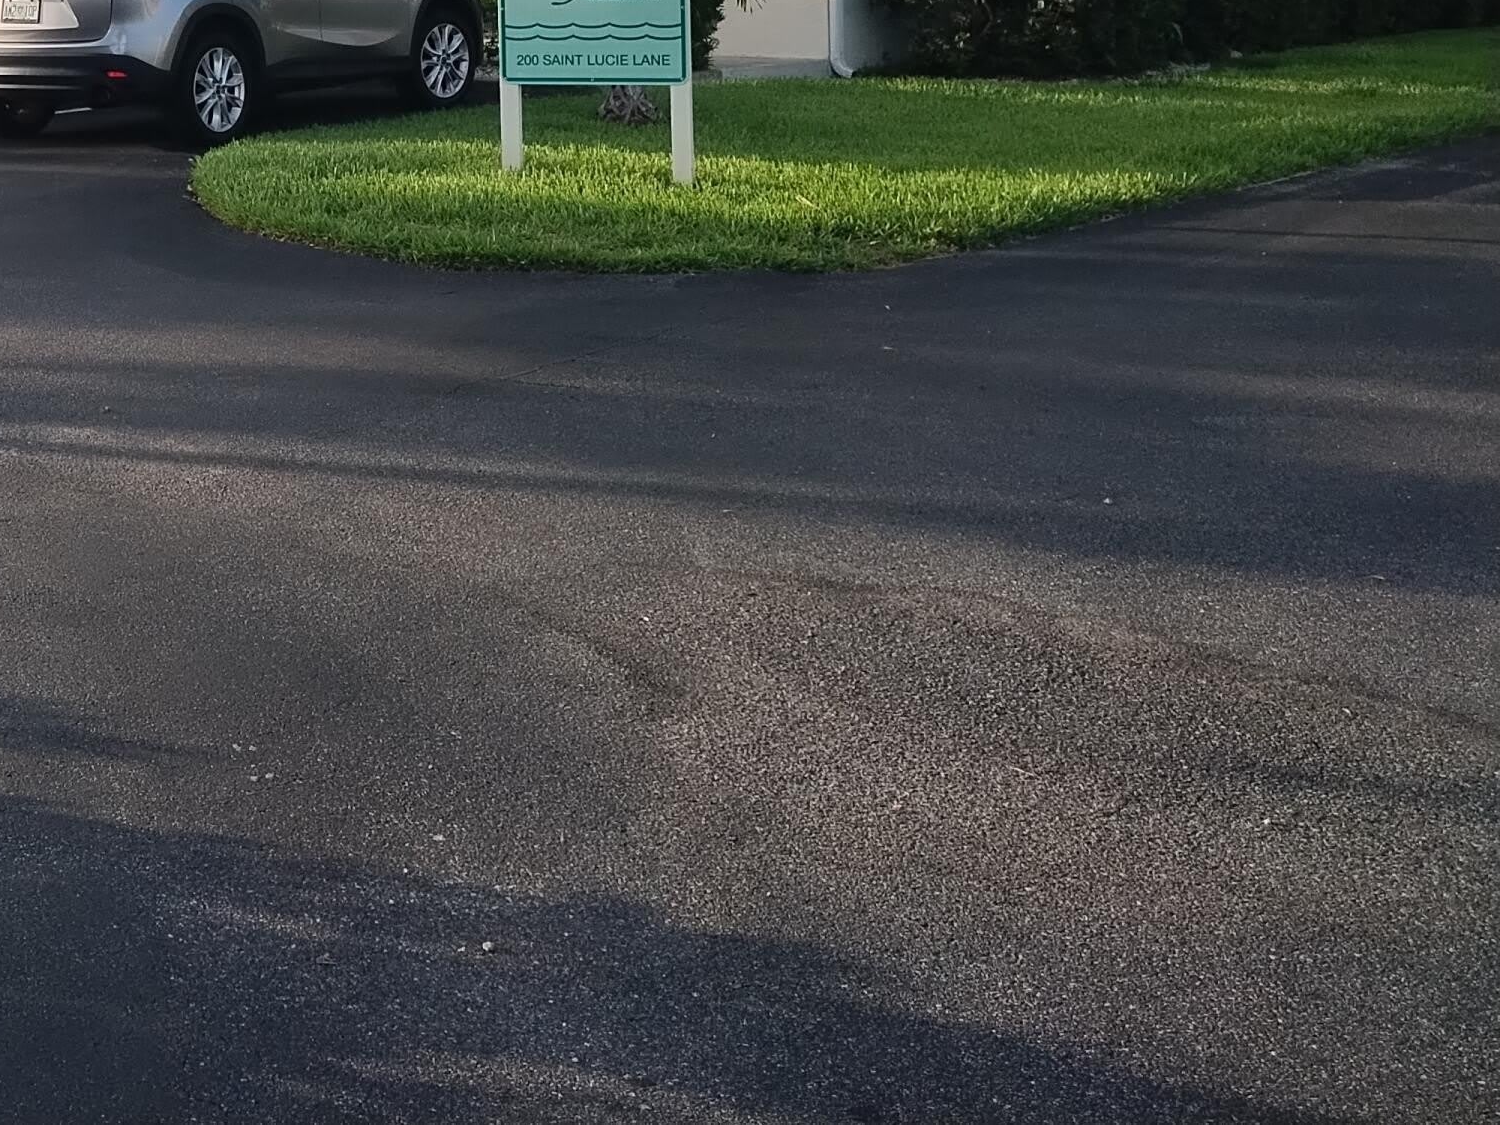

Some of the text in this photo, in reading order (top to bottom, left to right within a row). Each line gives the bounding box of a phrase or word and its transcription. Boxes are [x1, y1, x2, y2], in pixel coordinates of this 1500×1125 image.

[516, 54, 671, 66] 200 SAINT LUCIE LANE
